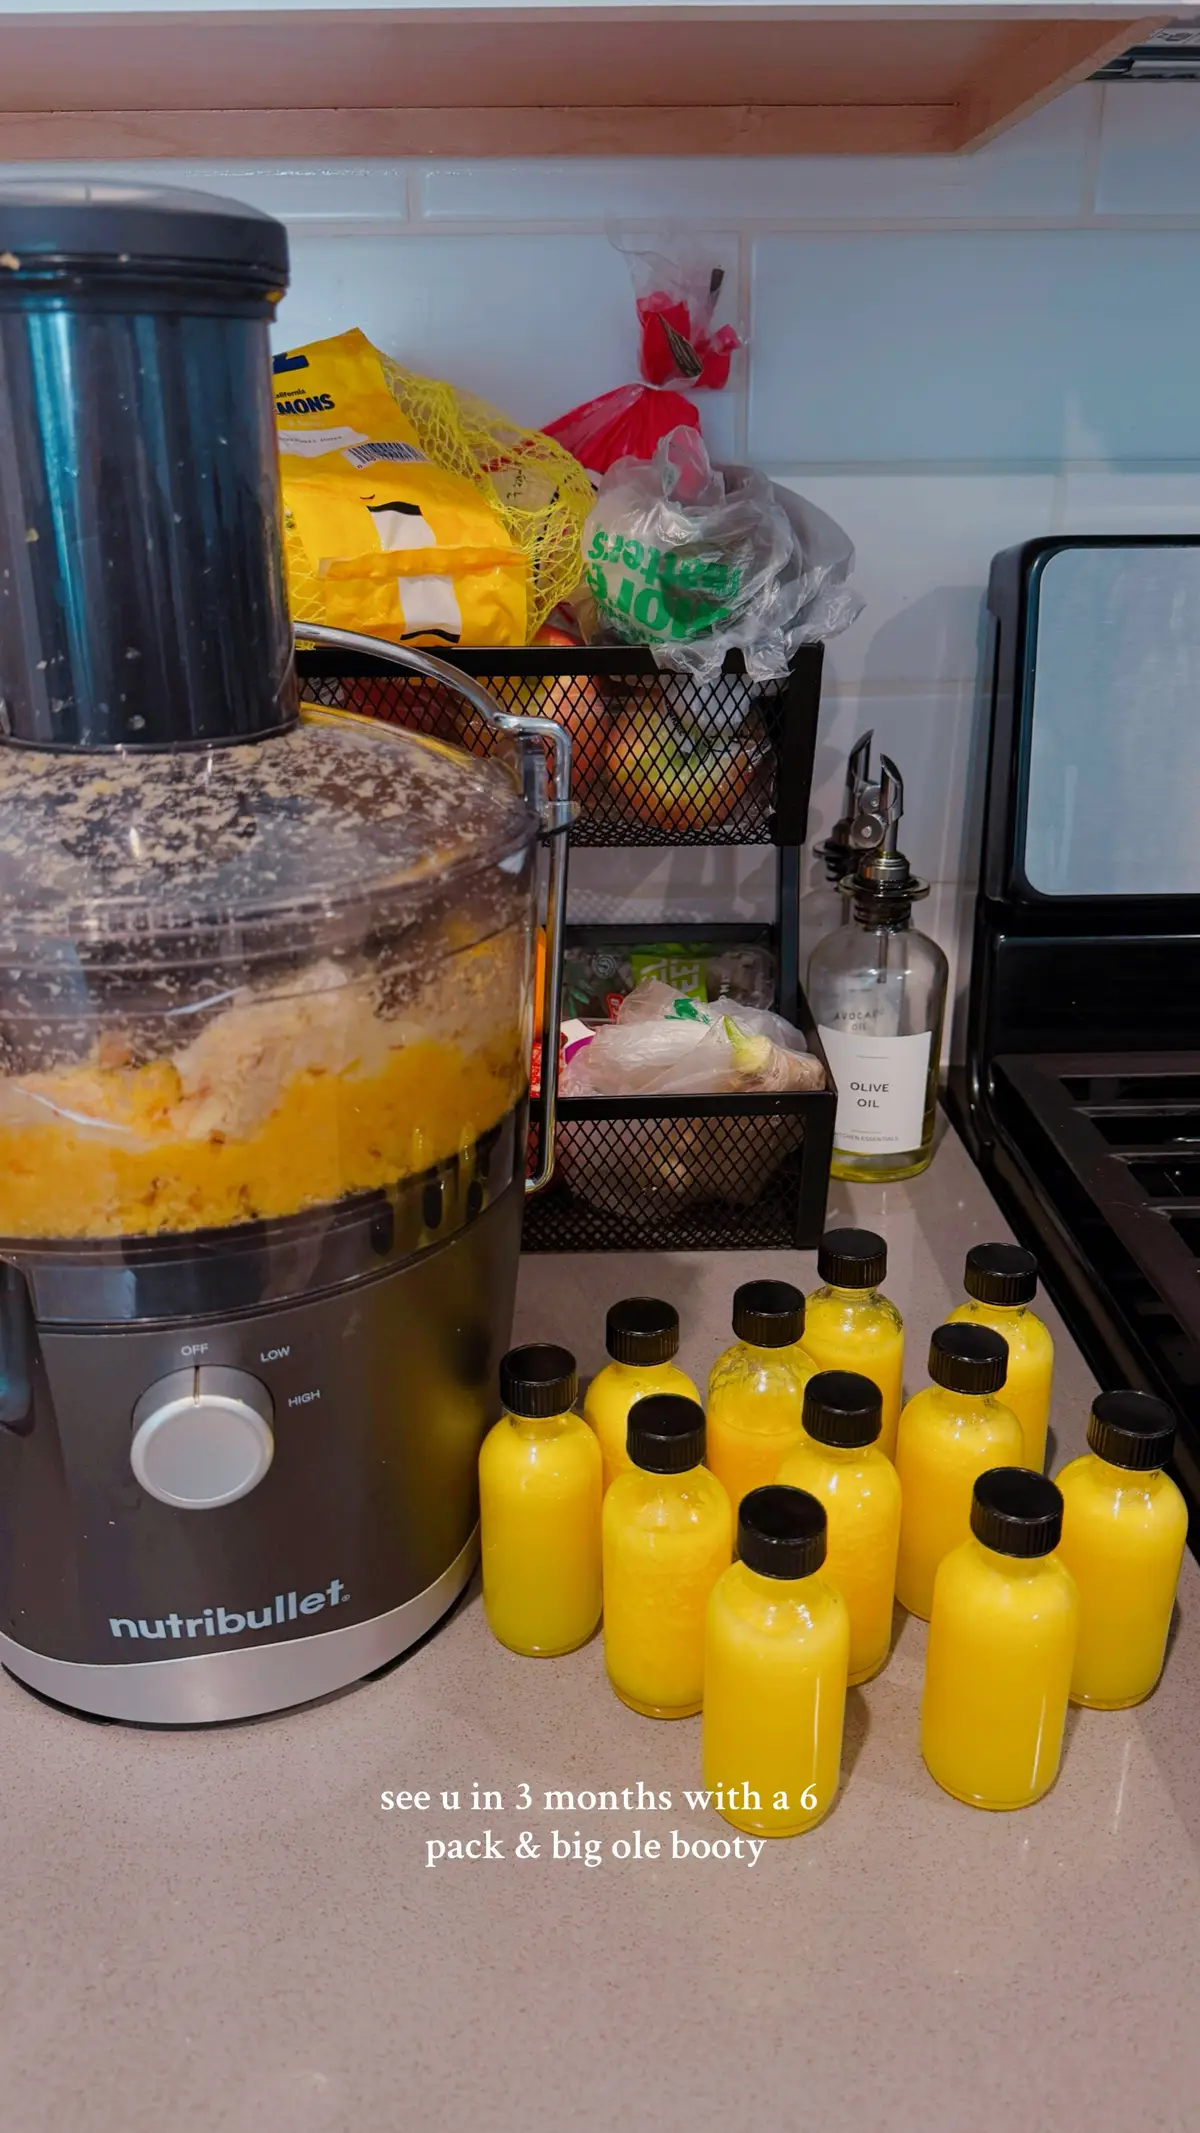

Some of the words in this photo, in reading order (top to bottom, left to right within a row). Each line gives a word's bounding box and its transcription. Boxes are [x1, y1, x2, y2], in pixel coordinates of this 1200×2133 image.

[275, 388, 307, 398] alifornia
[275, 393, 336, 415] MONS
[849, 1081, 890, 1093] OLIVE
[856, 1098, 880, 1109] OIL
[180, 1343, 209, 1356] OFF
[260, 1345, 291, 1362] LOW
[287, 1389, 321, 1407] HIGH
[109, 1578, 345, 1638] nutribullet
